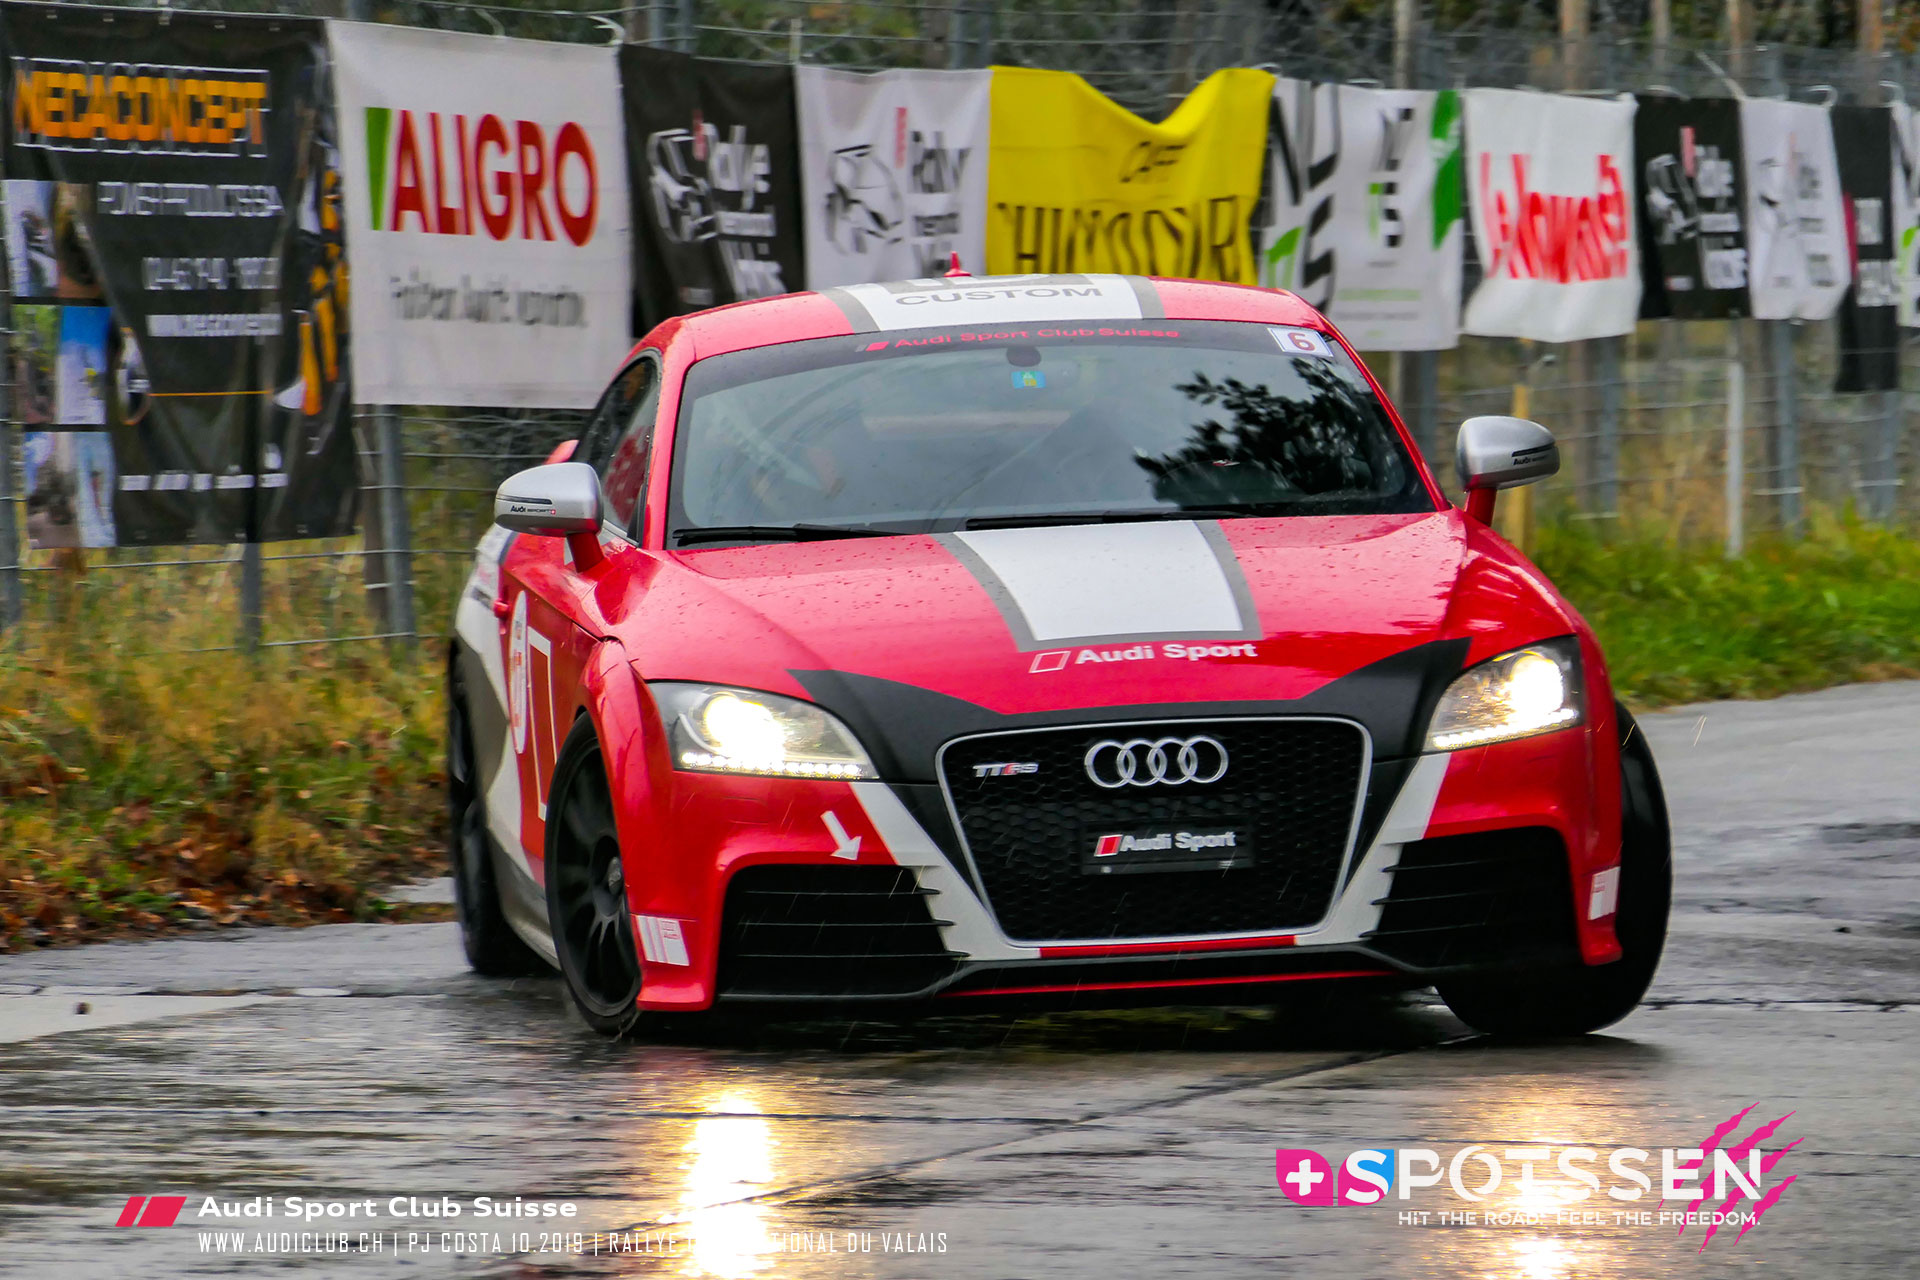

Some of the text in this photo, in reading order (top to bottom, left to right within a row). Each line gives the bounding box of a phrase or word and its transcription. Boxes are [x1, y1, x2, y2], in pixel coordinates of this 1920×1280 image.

[389, 109, 599, 247] ALIGRO
[895, 287, 1103, 306] CUSTOM
[894, 327, 1180, 349] Audi Sport Club Suisse
[1287, 332, 1316, 352] 6
[510, 505, 526, 513] Audi
[1074, 643, 1258, 665] Audi Sport
[1119, 831, 1236, 852] Audi Sport
